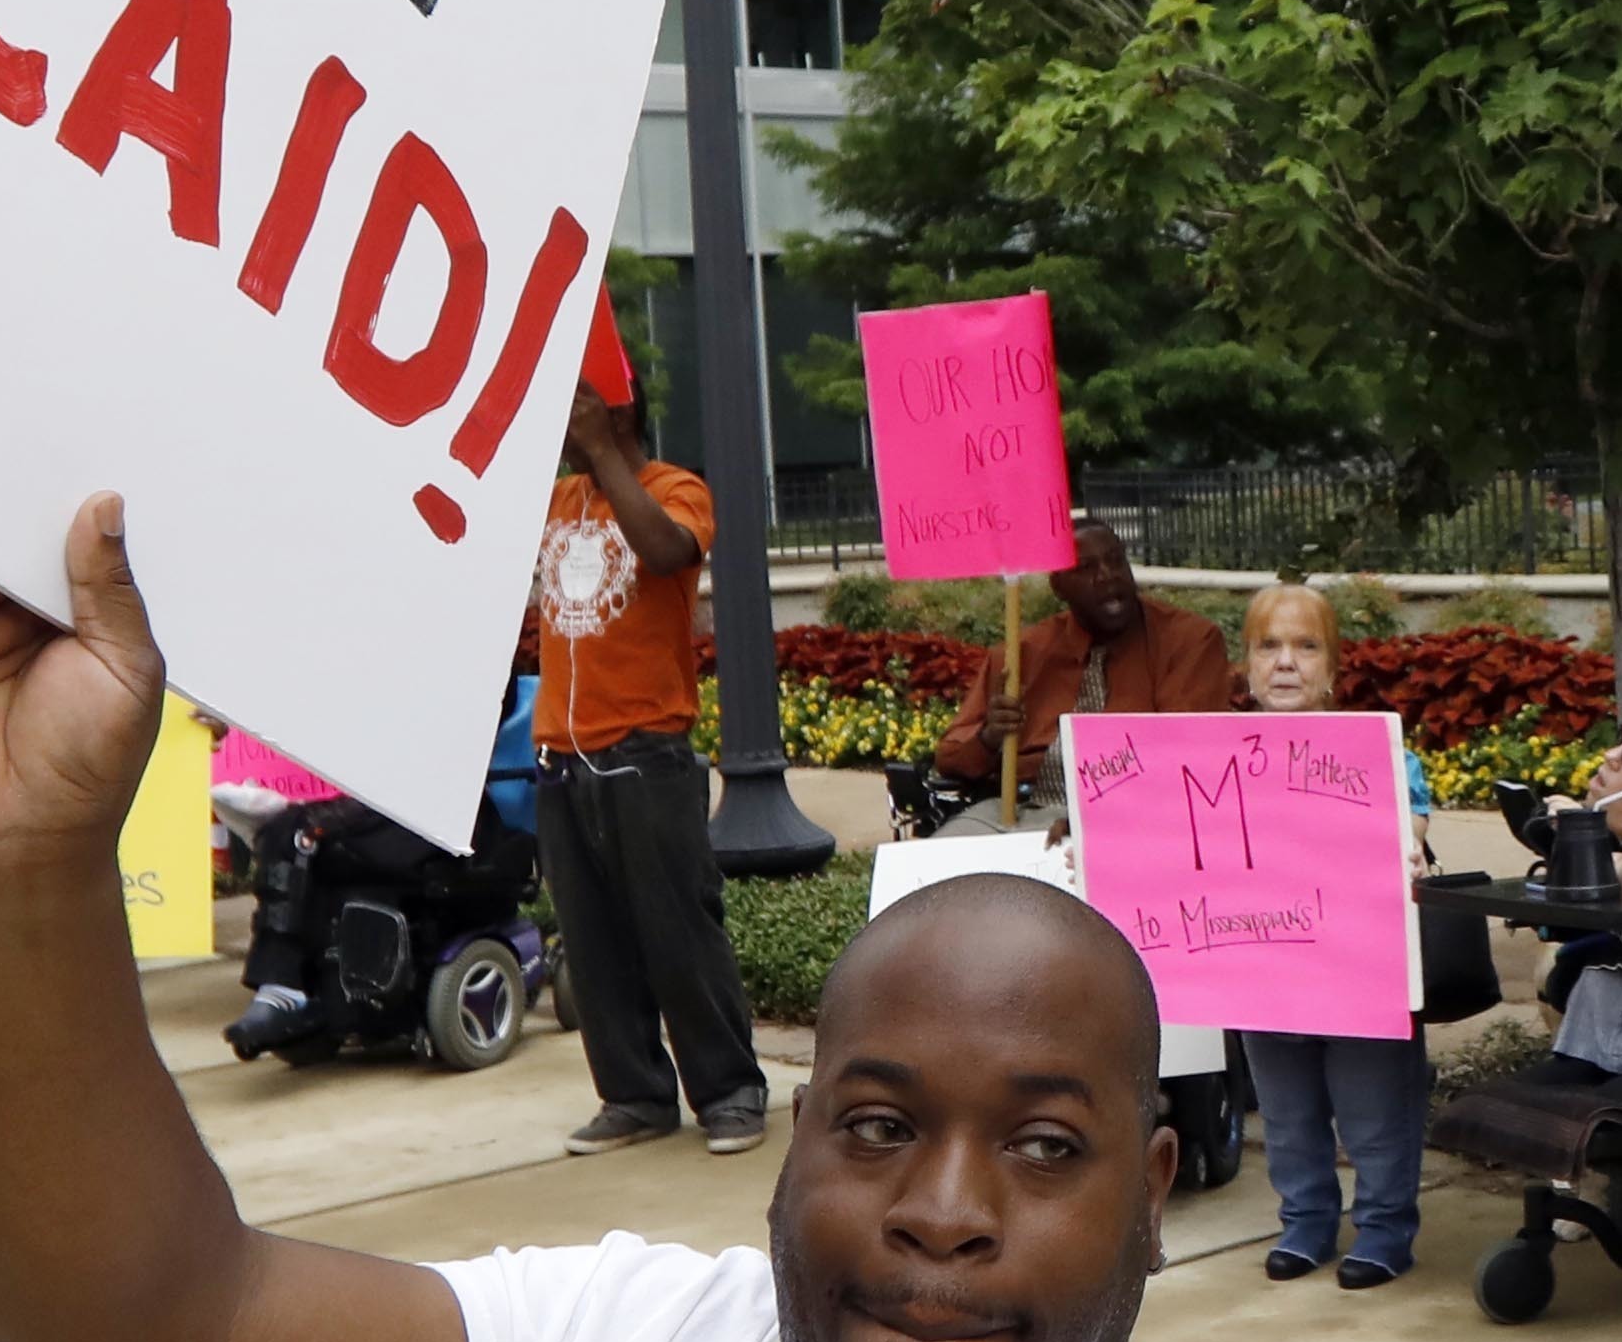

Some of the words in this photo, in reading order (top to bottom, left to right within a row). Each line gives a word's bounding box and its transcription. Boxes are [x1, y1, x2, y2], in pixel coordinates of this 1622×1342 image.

[898, 354, 971, 425] OUR
[964, 424, 1026, 475] NOT
[1134, 907, 1162, 946] to
